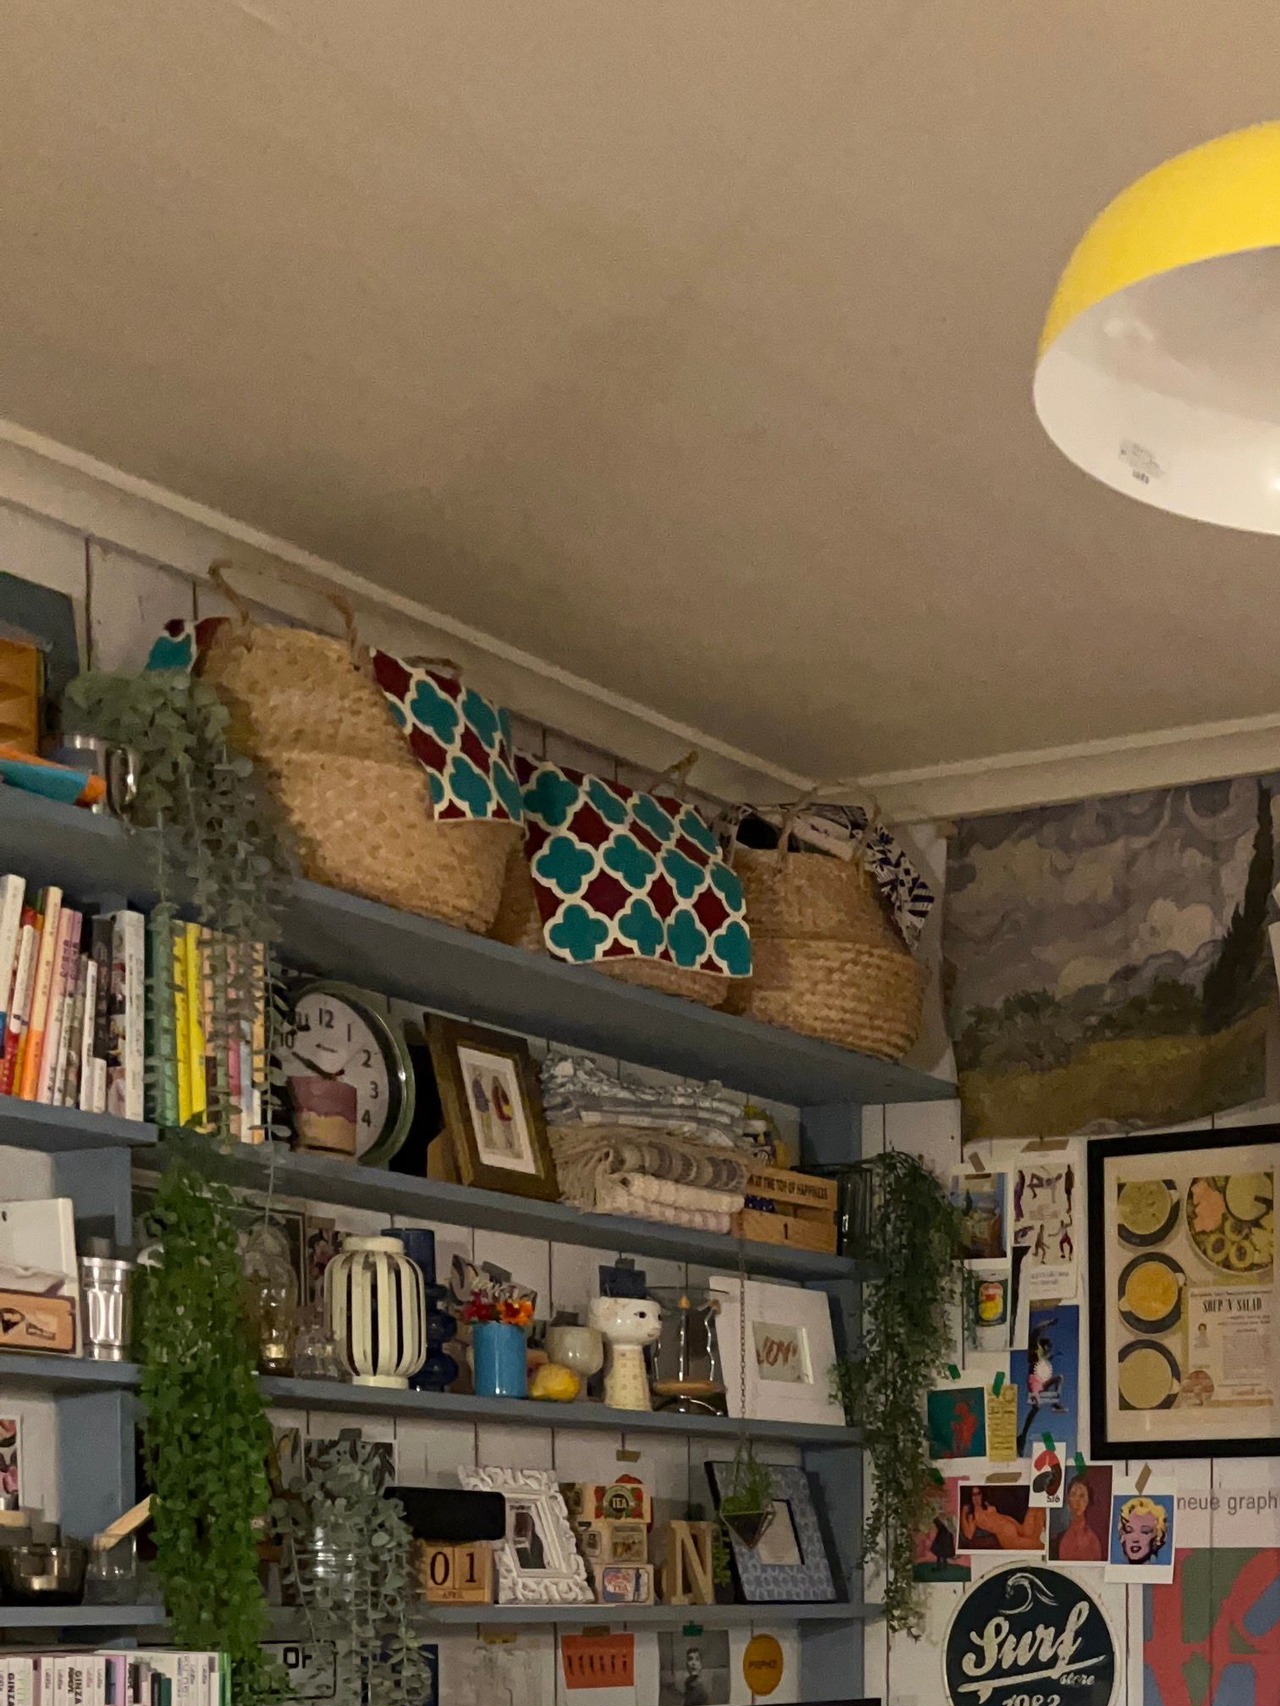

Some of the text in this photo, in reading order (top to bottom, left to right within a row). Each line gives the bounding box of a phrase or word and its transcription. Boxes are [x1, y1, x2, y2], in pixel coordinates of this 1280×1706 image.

[318, 1007, 335, 1029] 12
[361, 1048, 372, 1069] 2
[369, 1081, 379, 1100] 3
[361, 1109, 372, 1128] 4
[612, 1497, 627, 1509] TEA
[1176, 1494, 1220, 1511] neue
[962, 1601, 1090, 1680] Surf
[75, 1669, 83, 1705] GINZA
[1060, 1673, 1096, 1686] store
